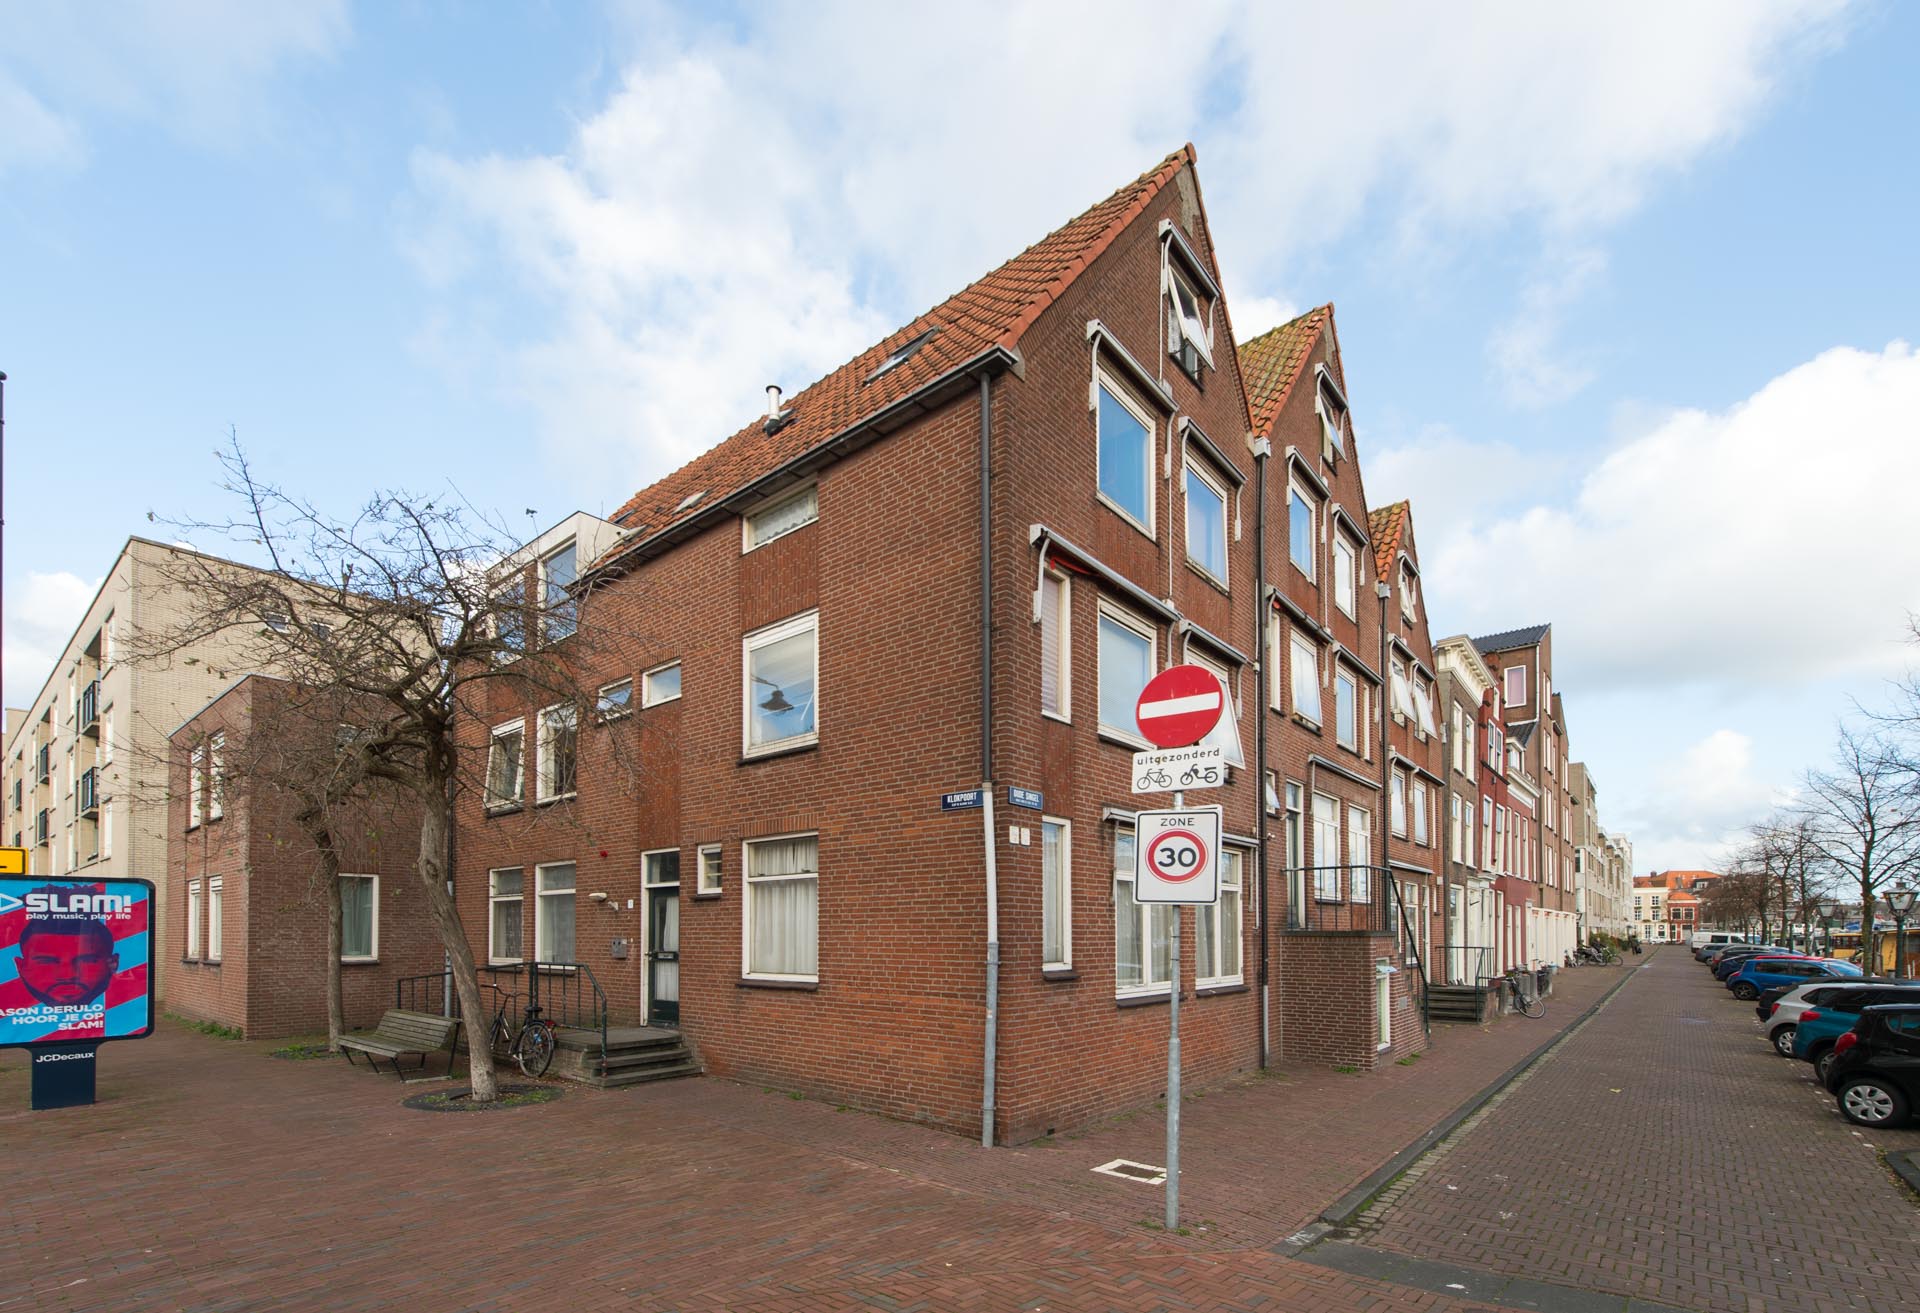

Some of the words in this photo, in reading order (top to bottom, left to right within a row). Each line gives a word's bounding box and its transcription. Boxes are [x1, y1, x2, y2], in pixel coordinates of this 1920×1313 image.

[1137, 748, 1220, 765] uitgezonderd
[947, 792, 977, 803] KLOKPOORT
[1160, 817, 1195, 827] ZONE
[1157, 847, 1197, 868] 30
[25, 893, 132, 913] SLAM!
[25, 912, 49, 920] play
[52, 912, 88, 920] music,
[90, 912, 113, 920] play
[115, 912, 132, 920] life
[42, 1004, 103, 1014] DERULO
[12, 1015, 58, 1024] HOOR
[62, 1013, 79, 1022] JE
[82, 1012, 104, 1020] OP
[58, 1021, 104, 1030] SLAM!
[36, 1052, 94, 1063] JCDecaux
